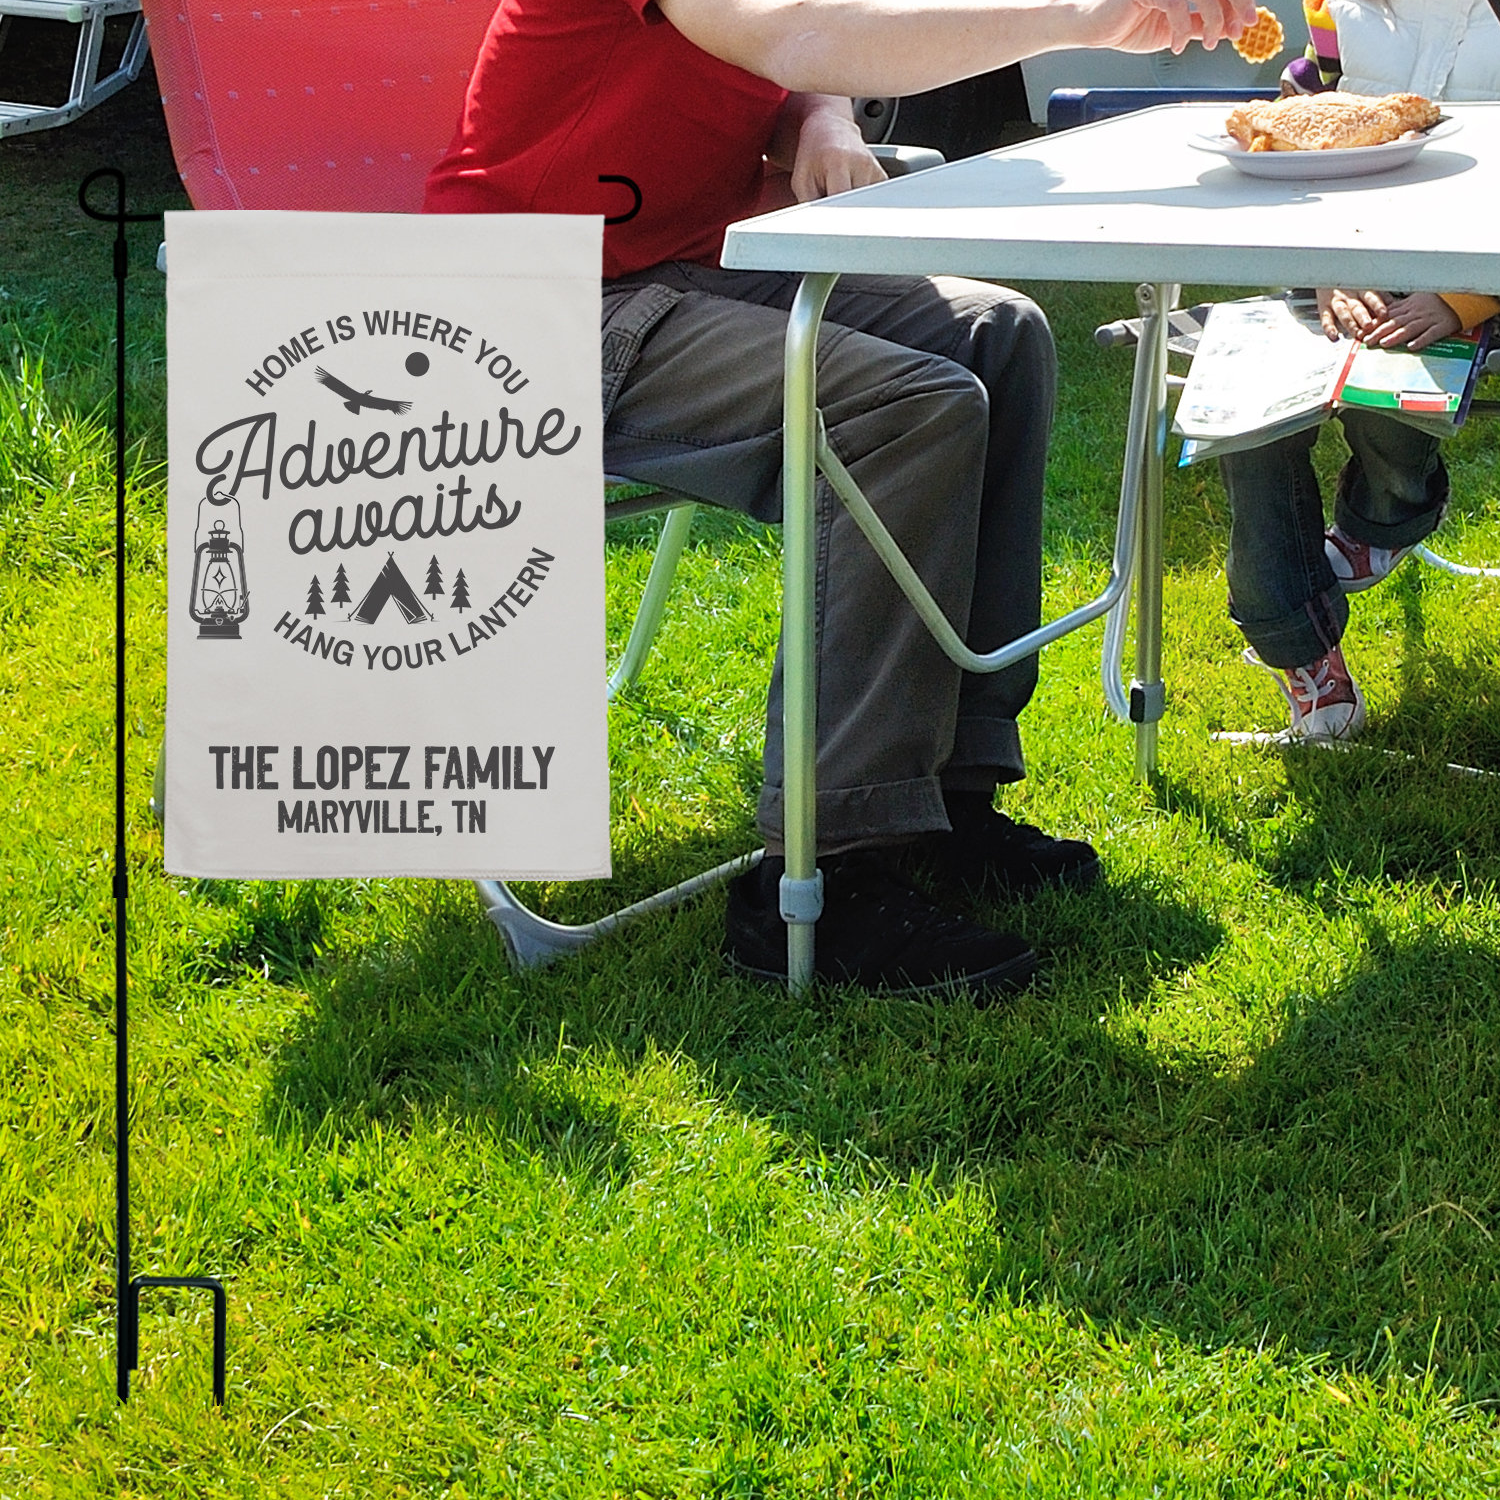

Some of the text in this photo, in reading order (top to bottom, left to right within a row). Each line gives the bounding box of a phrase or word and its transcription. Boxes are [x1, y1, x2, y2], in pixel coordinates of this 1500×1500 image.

[245, 310, 529, 396] HOME IS WHERE YOU
[196, 407, 581, 504] Adventure
[289, 475, 521, 555] awaits
[274, 547, 555, 671] HANG YOUR LANTERN
[209, 746, 555, 790] THE LOPEZ FAMILY
[278, 800, 486, 837] MARYVILLE, TN
